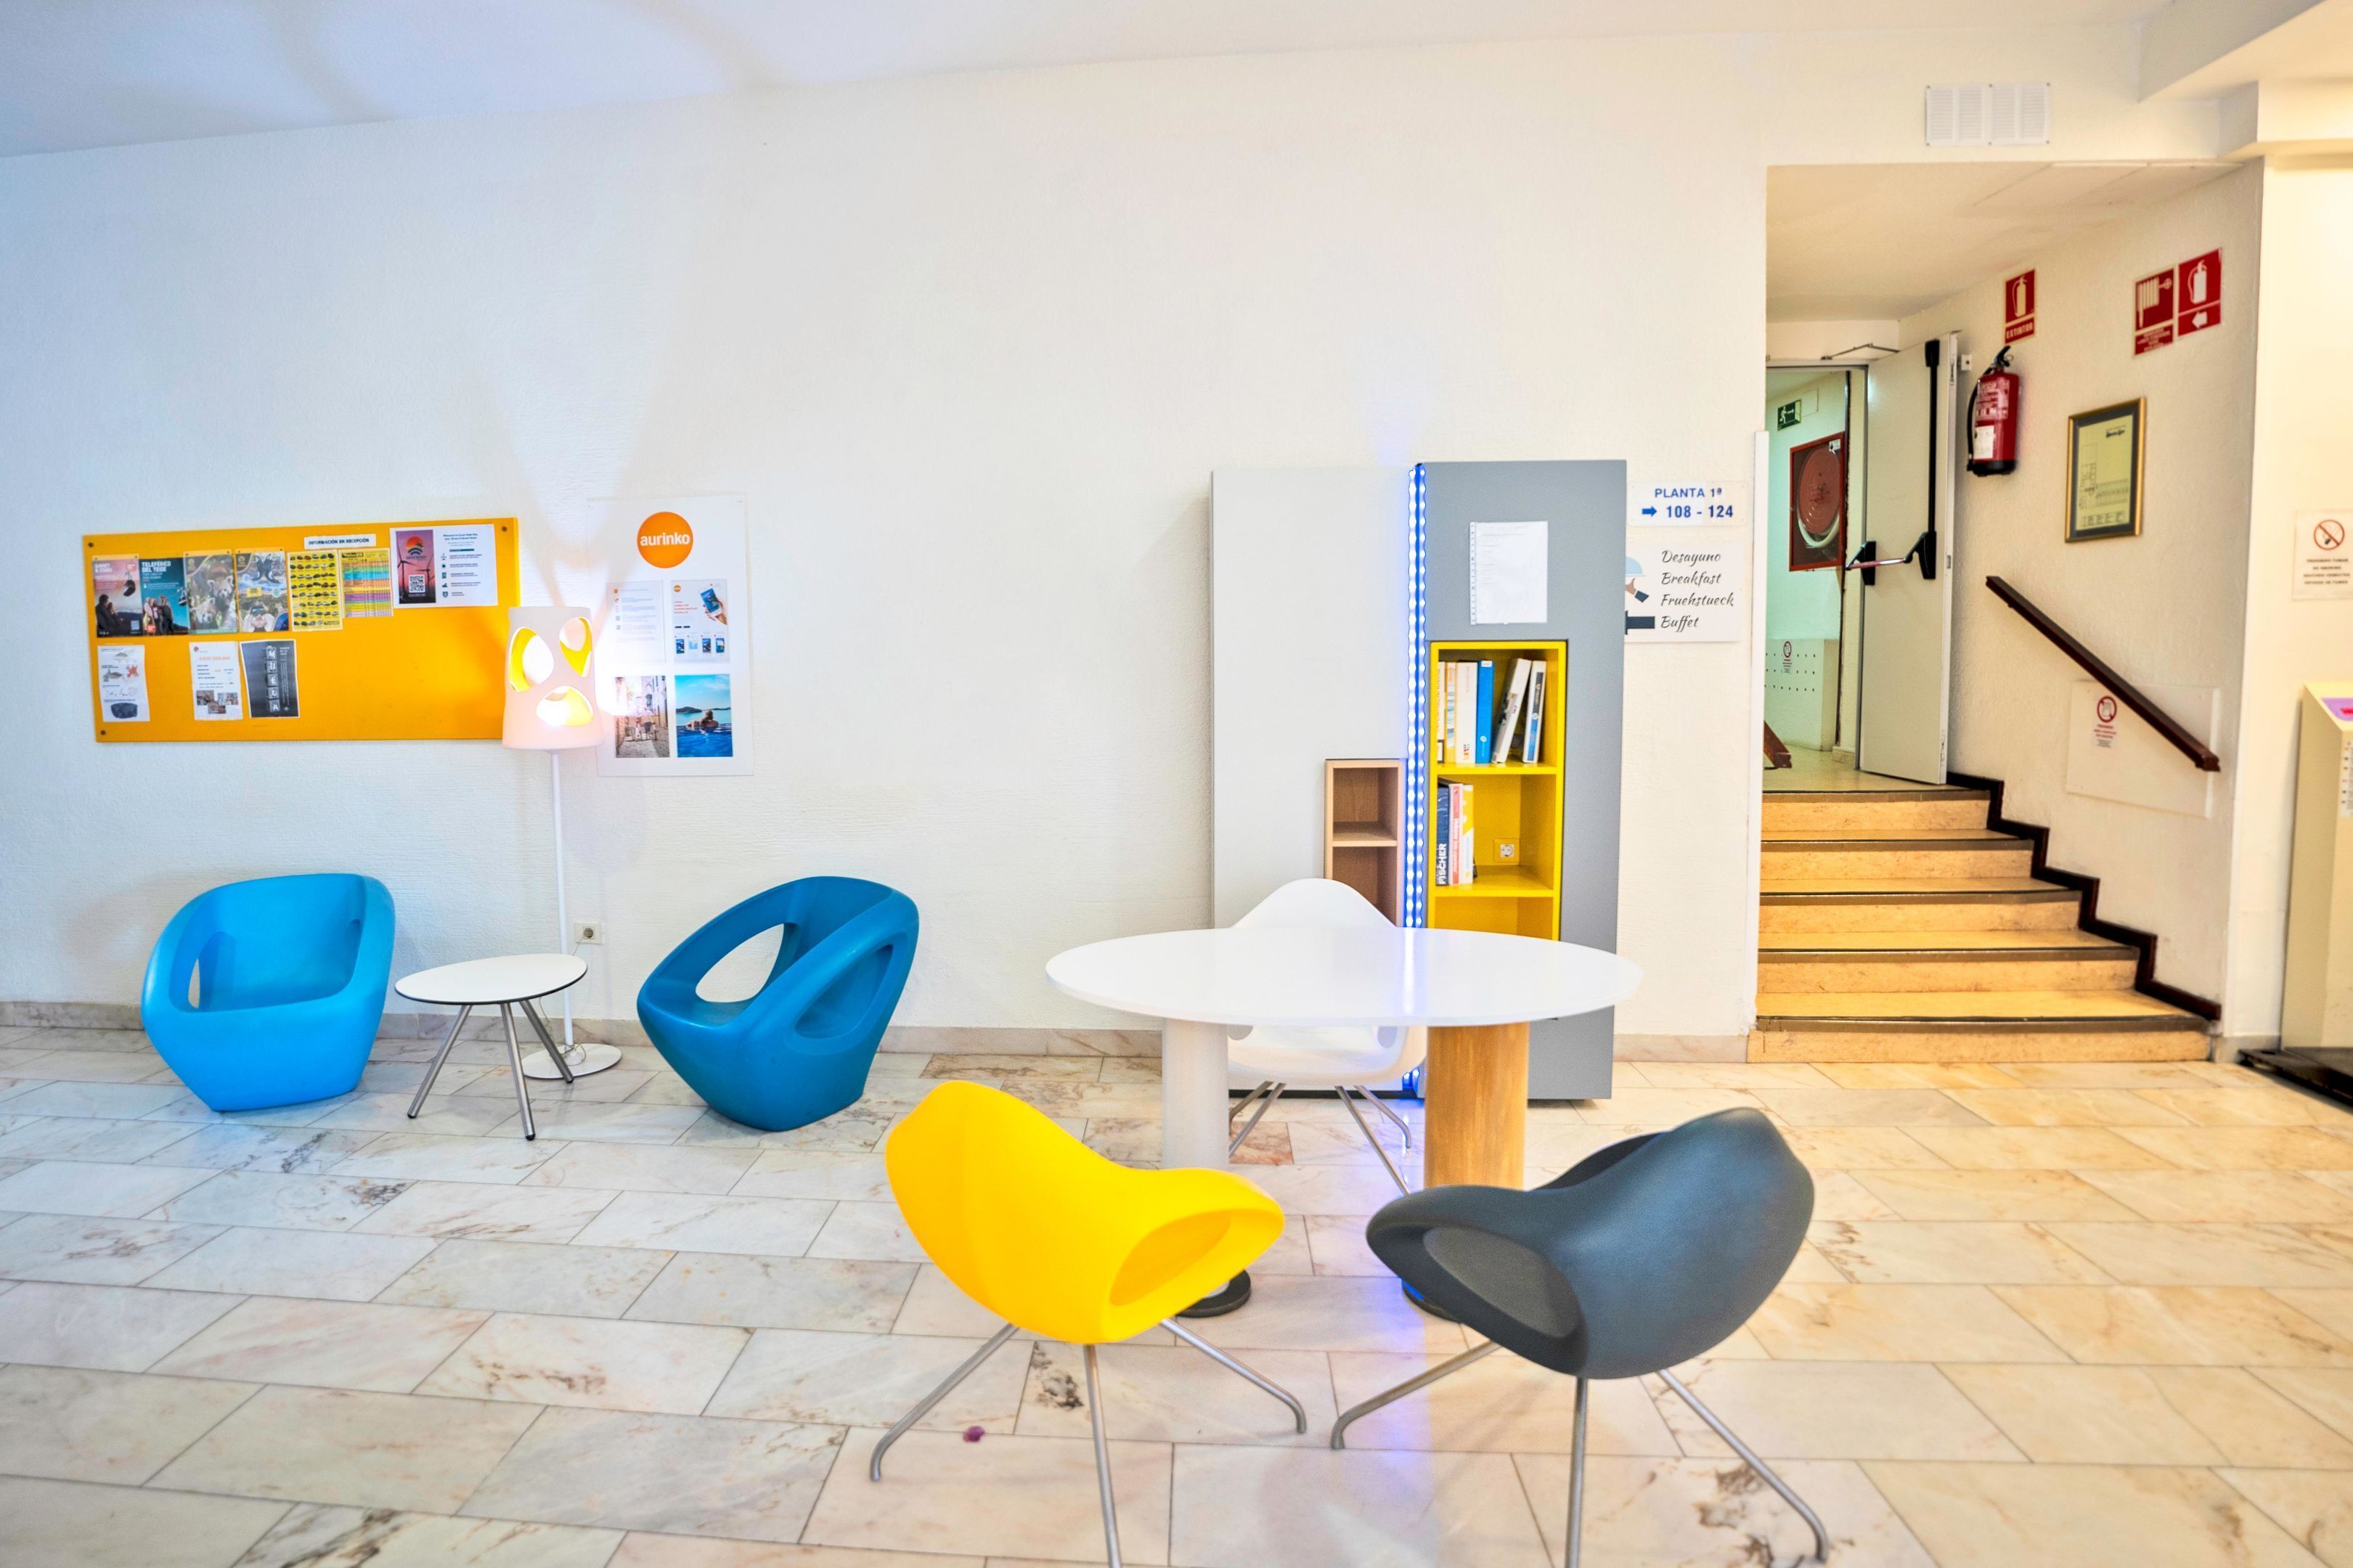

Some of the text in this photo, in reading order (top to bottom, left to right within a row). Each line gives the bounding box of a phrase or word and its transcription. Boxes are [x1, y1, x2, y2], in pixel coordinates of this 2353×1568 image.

[2006, 322, 2034, 339] EXTINTOR
[1655, 488, 1705, 498] PLANTA
[1666, 505, 1691, 518] 108
[1708, 505, 1734, 518] 124
[640, 531, 690, 546] aurinko
[1661, 550, 1721, 567] Desayuno
[1661, 571, 1722, 587] Breakfast
[1660, 592, 1734, 607] Fruehstueck
[1660, 615, 1700, 633] Buffet
[1438, 843, 1447, 885] FISCHER
